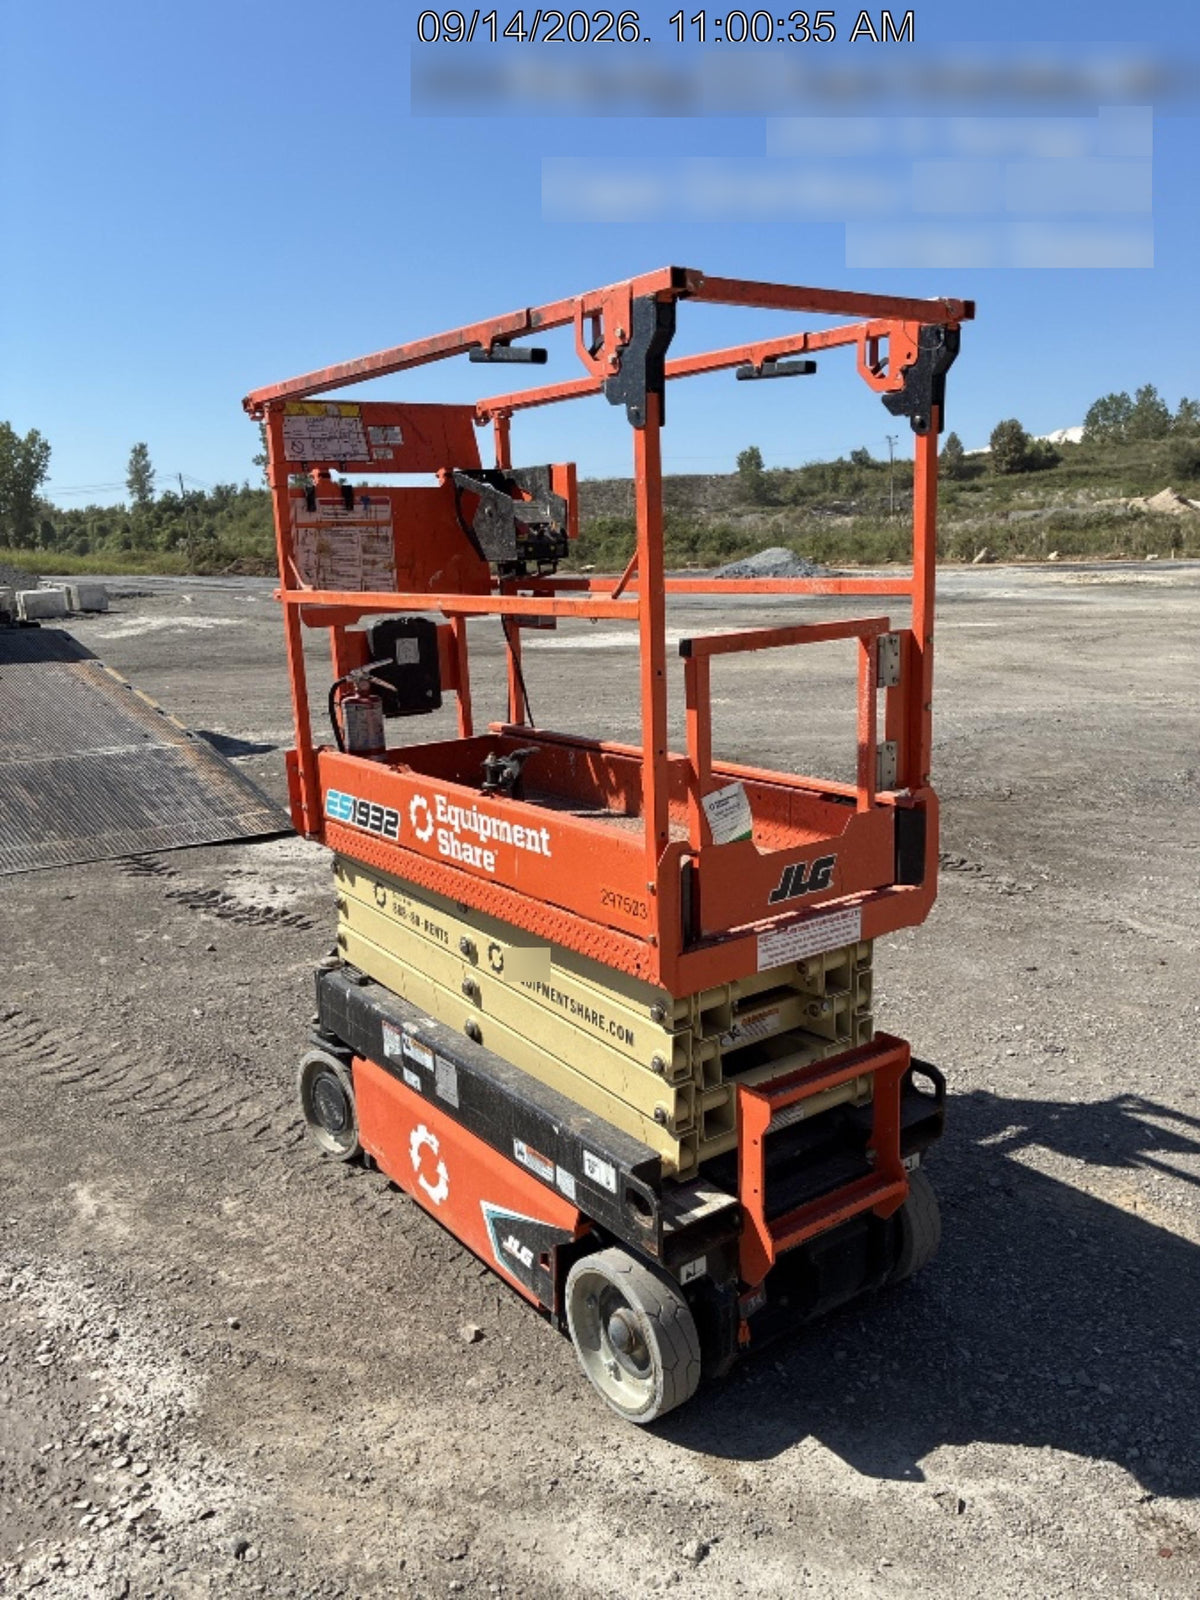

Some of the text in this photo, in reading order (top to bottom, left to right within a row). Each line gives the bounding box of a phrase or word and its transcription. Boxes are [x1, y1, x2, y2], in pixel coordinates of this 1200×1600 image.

[327, 790, 399, 840] ES1932
[434, 795, 552, 857] Equipment
[437, 828, 496, 873] Share
[768, 854, 838, 905] JLG
[502, 1235, 534, 1268] JLG
